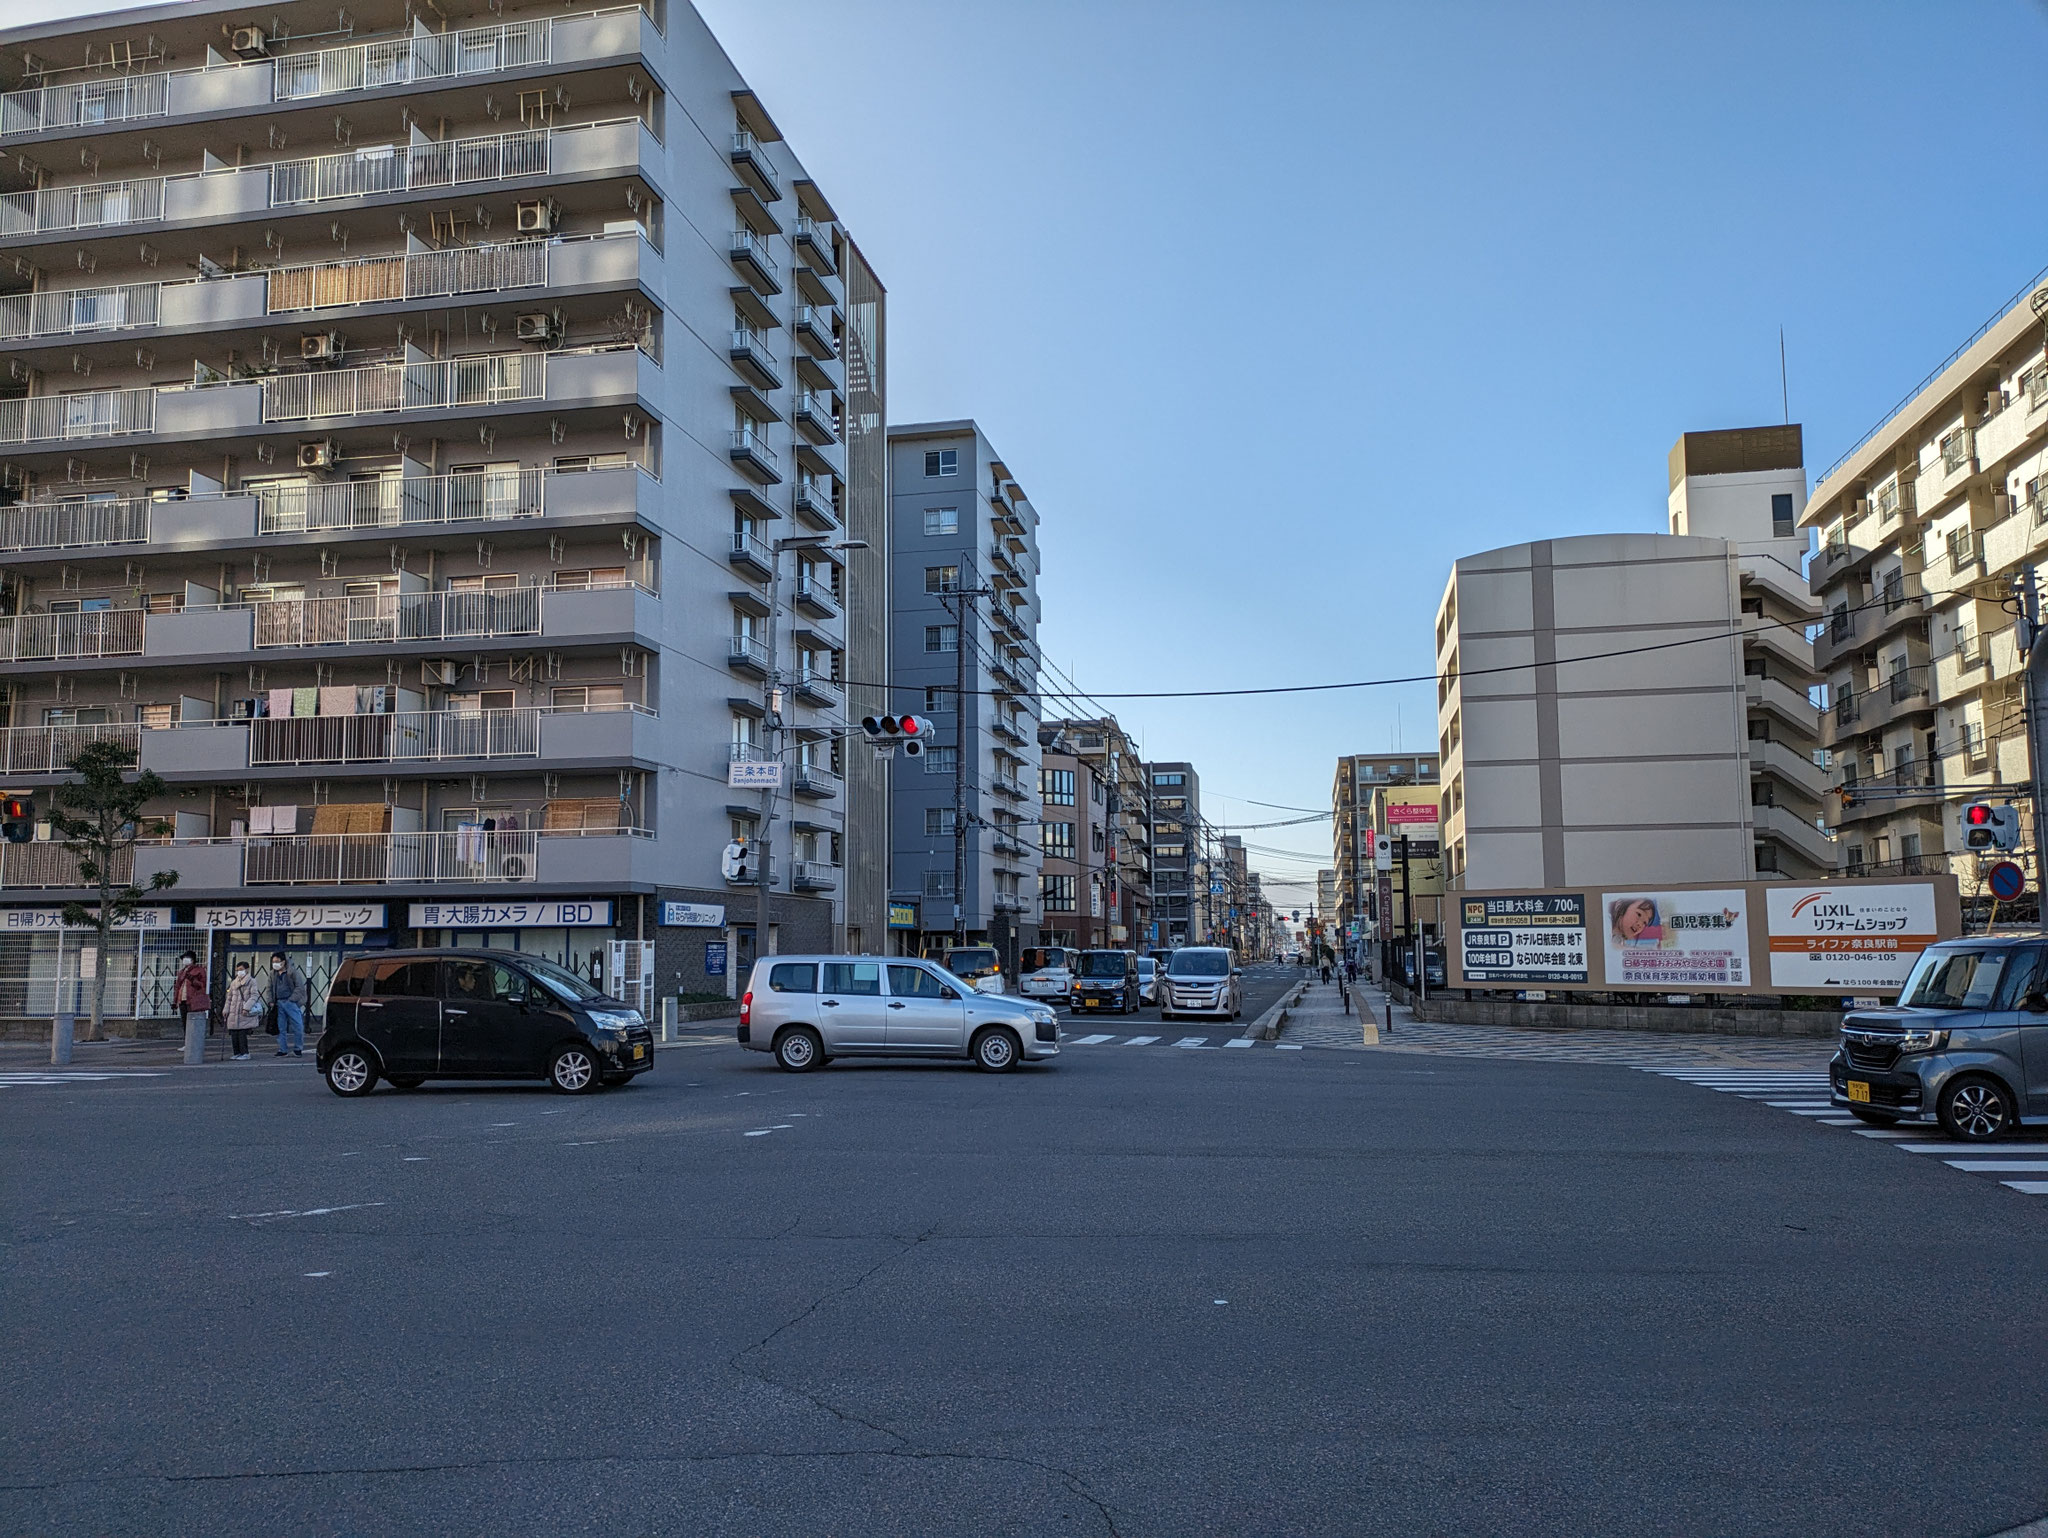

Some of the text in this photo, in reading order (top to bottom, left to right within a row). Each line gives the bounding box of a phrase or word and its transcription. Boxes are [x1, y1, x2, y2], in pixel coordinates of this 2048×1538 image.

[733, 765, 778, 777] 三条本町
[733, 777, 778, 785] Sanjohonmachi
[1393, 807, 1433, 815] さくら整体院
[1467, 904, 1483, 914] NPC
[1487, 899, 1544, 913] 当日最大料金
[1554, 899, 1580, 912] 700円
[1813, 904, 1855, 917] LIXIL
[206, 907, 373, 927] なら内視鏡クリニック
[424, 905, 528, 924] 胃・大腸カメラ
[556, 904, 593, 923] IBD
[1671, 915, 1726, 929] 園児募集
[1814, 916, 1908, 931] リフォームショップ
[1466, 934, 1497, 946] JR奈良駅
[1515, 933, 1566, 946] ホテル日航奈良
[1567, 933, 1583, 946] 地下
[1806, 938, 1899, 949] ライファ奈良駅前
[1467, 953, 1498, 965] 100年会館
[1516, 952, 1567, 966] なら100年会館
[1568, 952, 1584, 966] 北東
[1825, 953, 1897, 961] 0120-046-105
[1624, 971, 1727, 981] 奈良保育学院付属幼稚園
